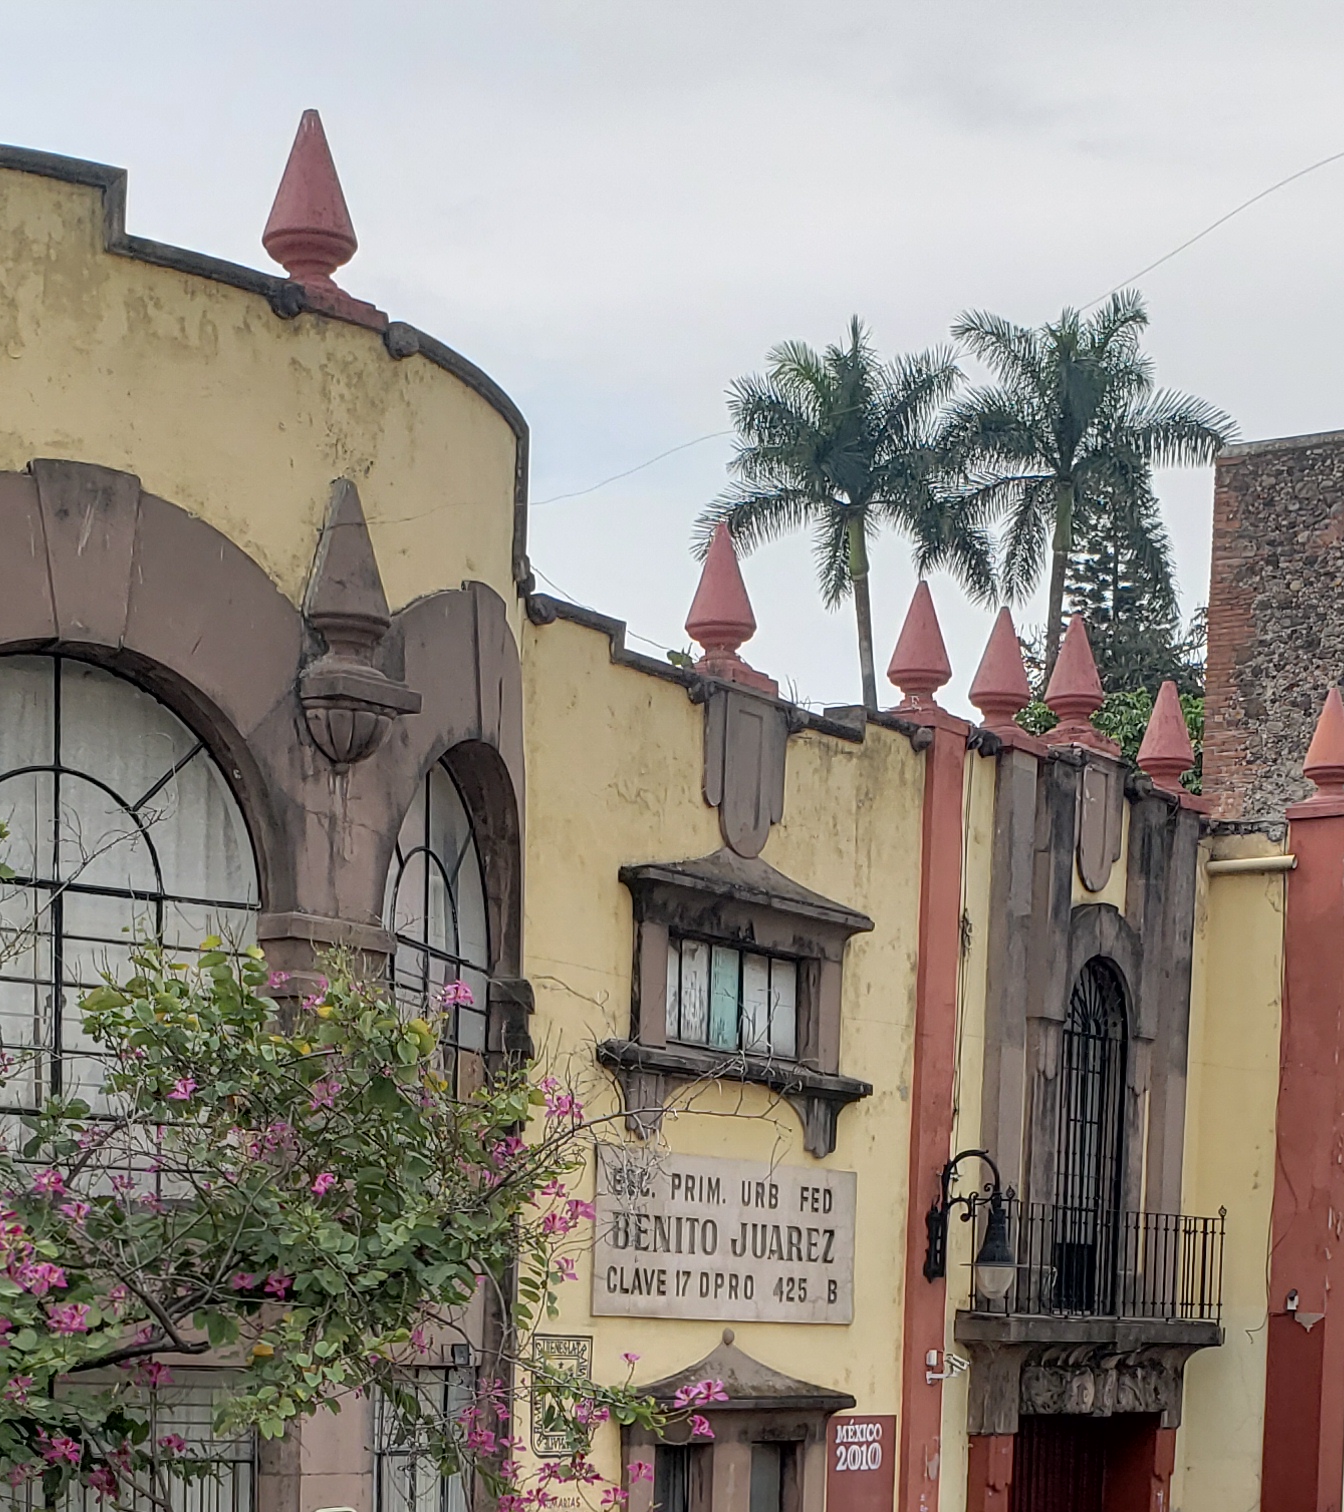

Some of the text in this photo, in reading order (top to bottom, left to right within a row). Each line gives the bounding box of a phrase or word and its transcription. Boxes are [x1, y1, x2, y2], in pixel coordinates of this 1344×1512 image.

[671, 1172, 727, 1205] PRIM.
[741, 1177, 779, 1210] URB
[799, 1185, 834, 1215] FED
[612, 1211, 837, 1264] BENITO JUAREZ
[606, 1264, 667, 1297] CLAVE
[675, 1269, 691, 1297] 17
[772, 1275, 808, 1303] 425
[826, 1278, 838, 1305] B
[834, 1418, 883, 1443] MÉXICO
[835, 1442, 883, 1471] 2010
